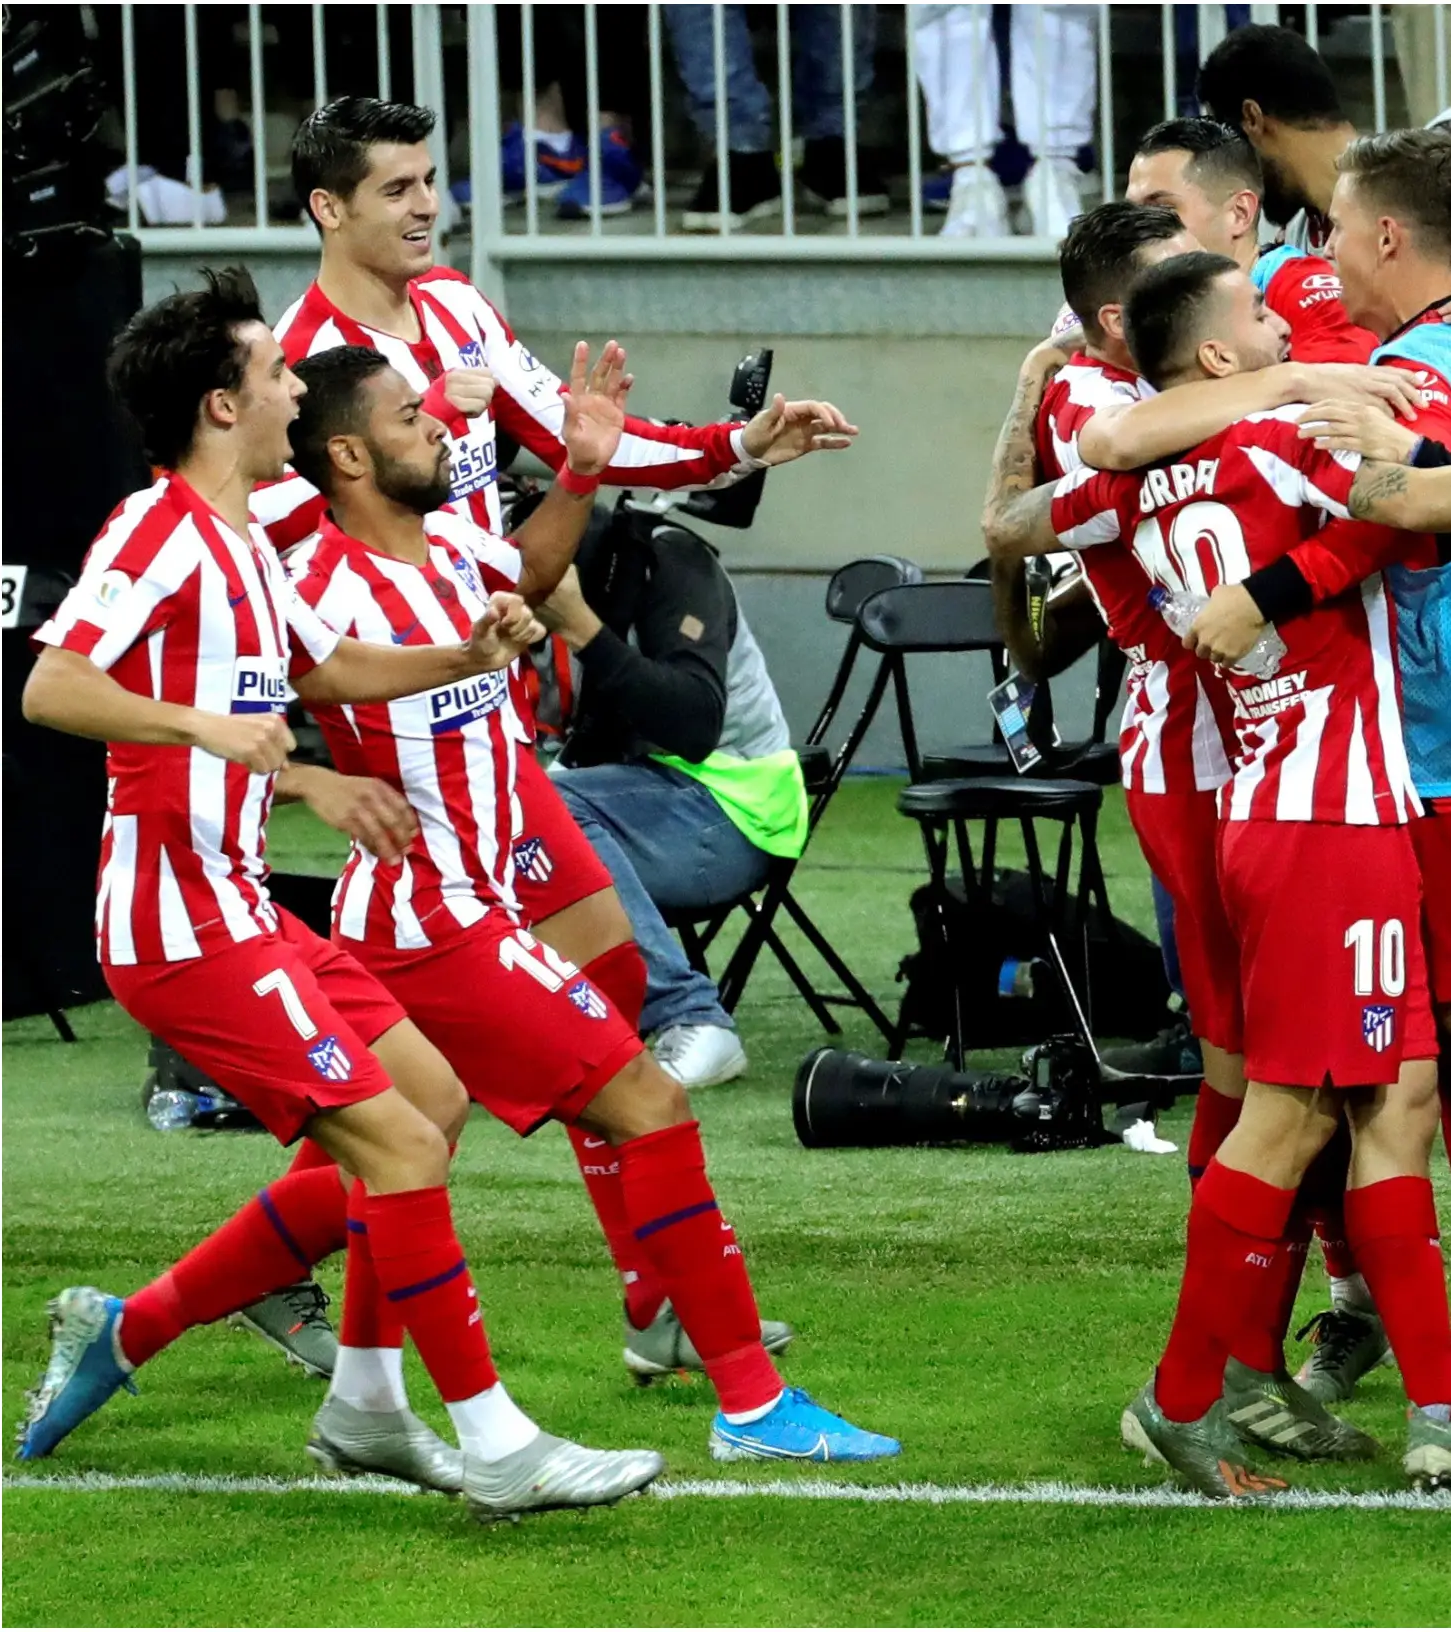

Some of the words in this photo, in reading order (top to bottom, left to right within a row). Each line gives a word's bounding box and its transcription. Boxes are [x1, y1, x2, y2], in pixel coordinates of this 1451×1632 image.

[1299, 289, 1343, 309] HYUN
[1131, 501, 1251, 597] 10
[237, 671, 286, 698] Plus
[499, 928, 580, 993] 12
[1344, 919, 1406, 997] 10
[252, 968, 318, 1041] 7
